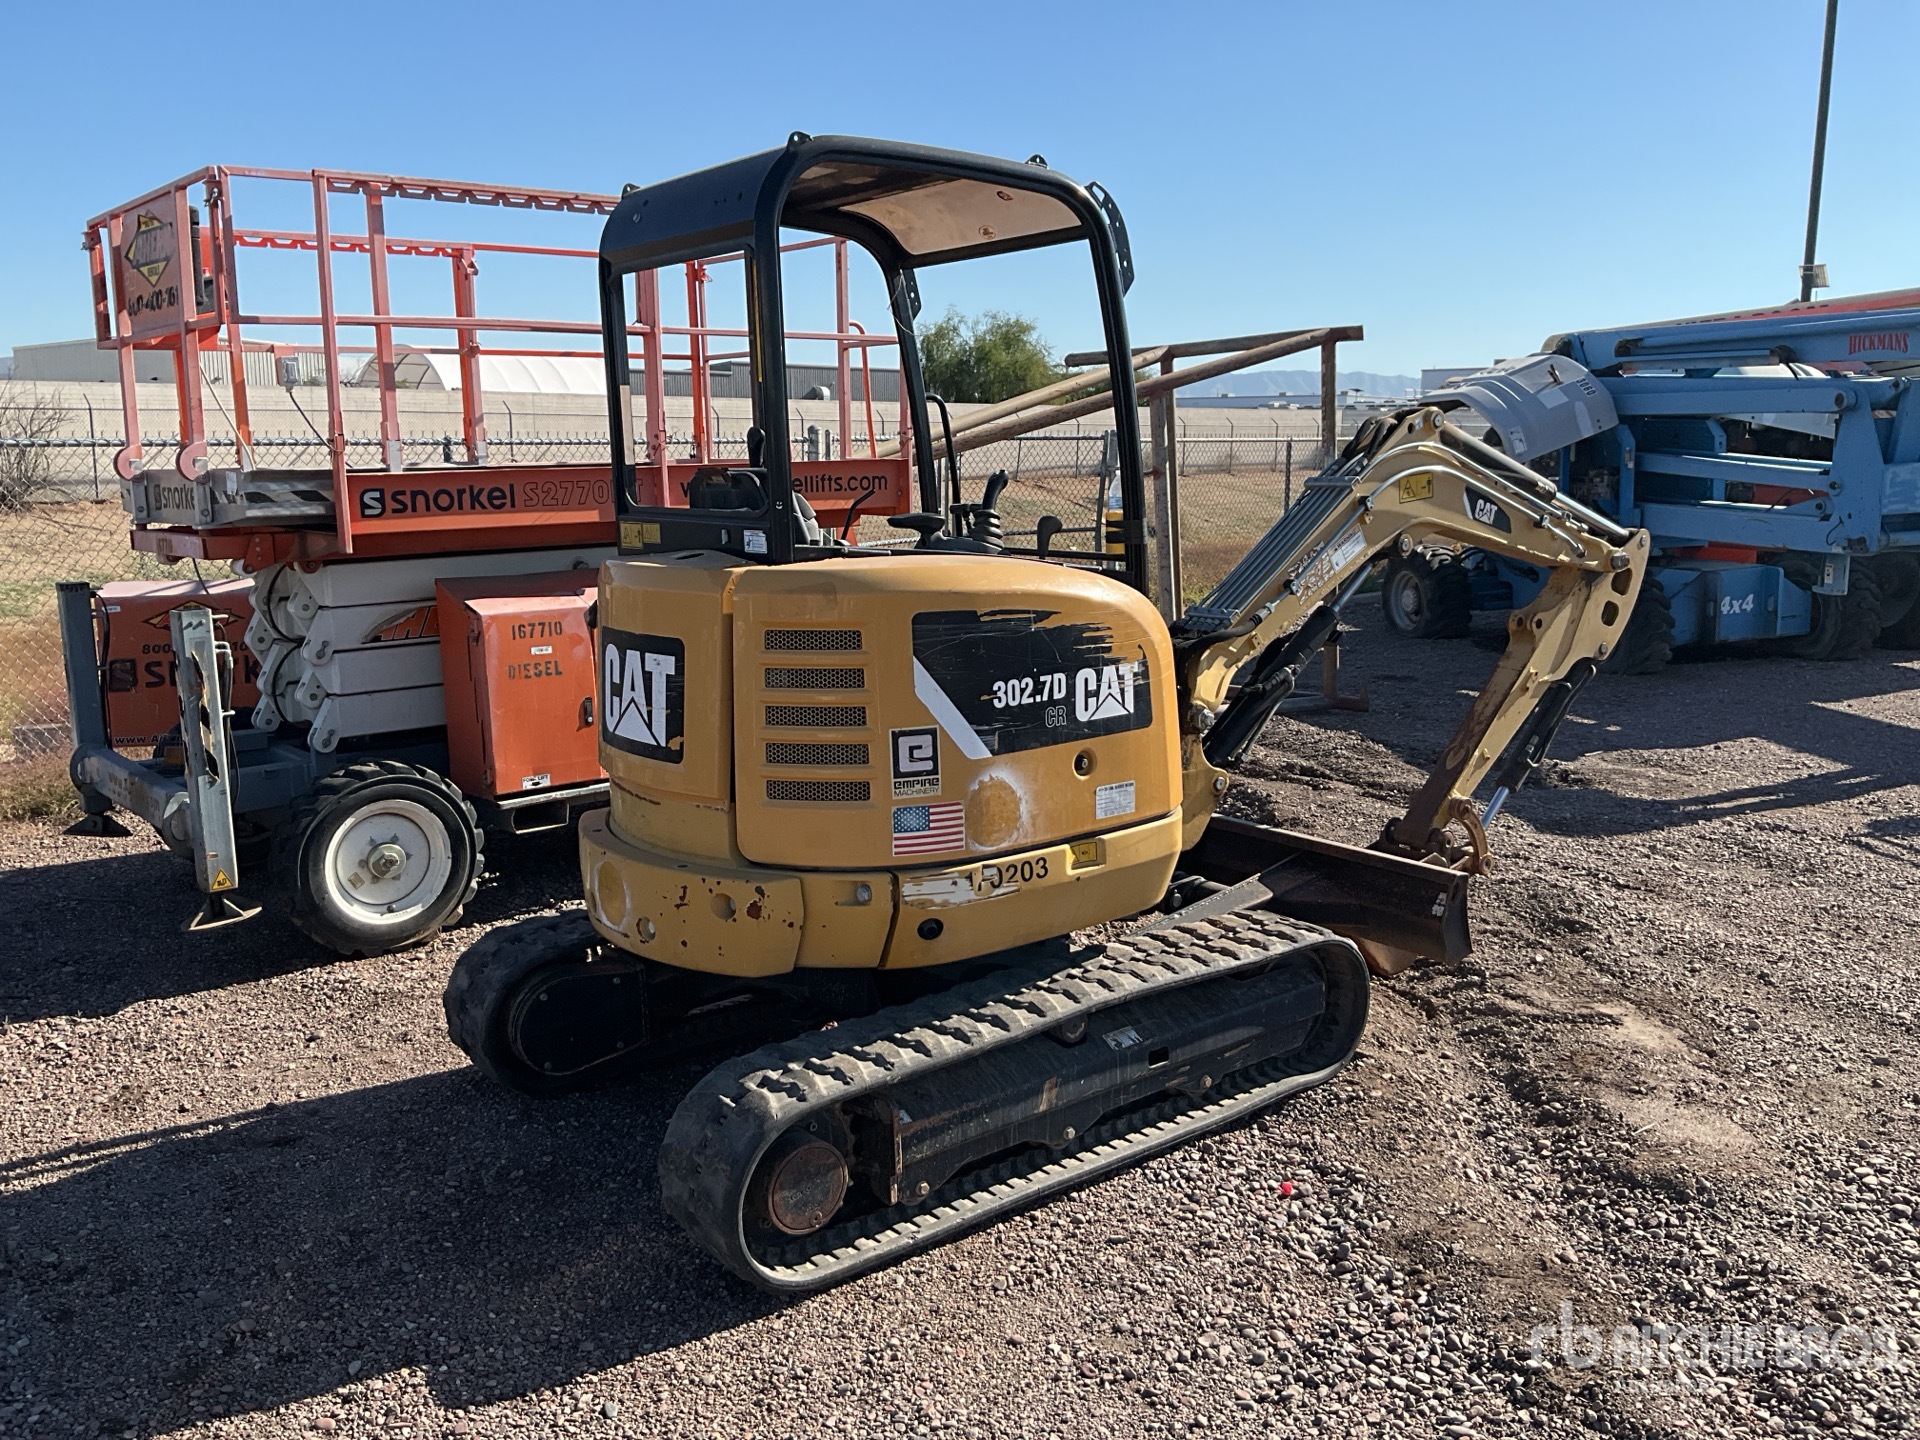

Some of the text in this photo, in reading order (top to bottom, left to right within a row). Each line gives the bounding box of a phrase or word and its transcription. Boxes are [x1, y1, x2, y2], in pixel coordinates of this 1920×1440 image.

[1849, 332, 1909, 355] HICKMANS
[162, 484, 195, 510] snorke
[391, 484, 516, 513] snorkel
[1475, 499, 1497, 525] CAT
[1721, 594, 1754, 614] 4x4
[511, 621, 563, 640] 167710
[508, 660, 563, 679] DIESEL
[605, 643, 675, 748] CAT
[992, 673, 1066, 708] 302.7D
[1075, 661, 1139, 722] CAT
[1045, 705, 1067, 728] CR
[894, 786, 940, 798] MACHINERY
